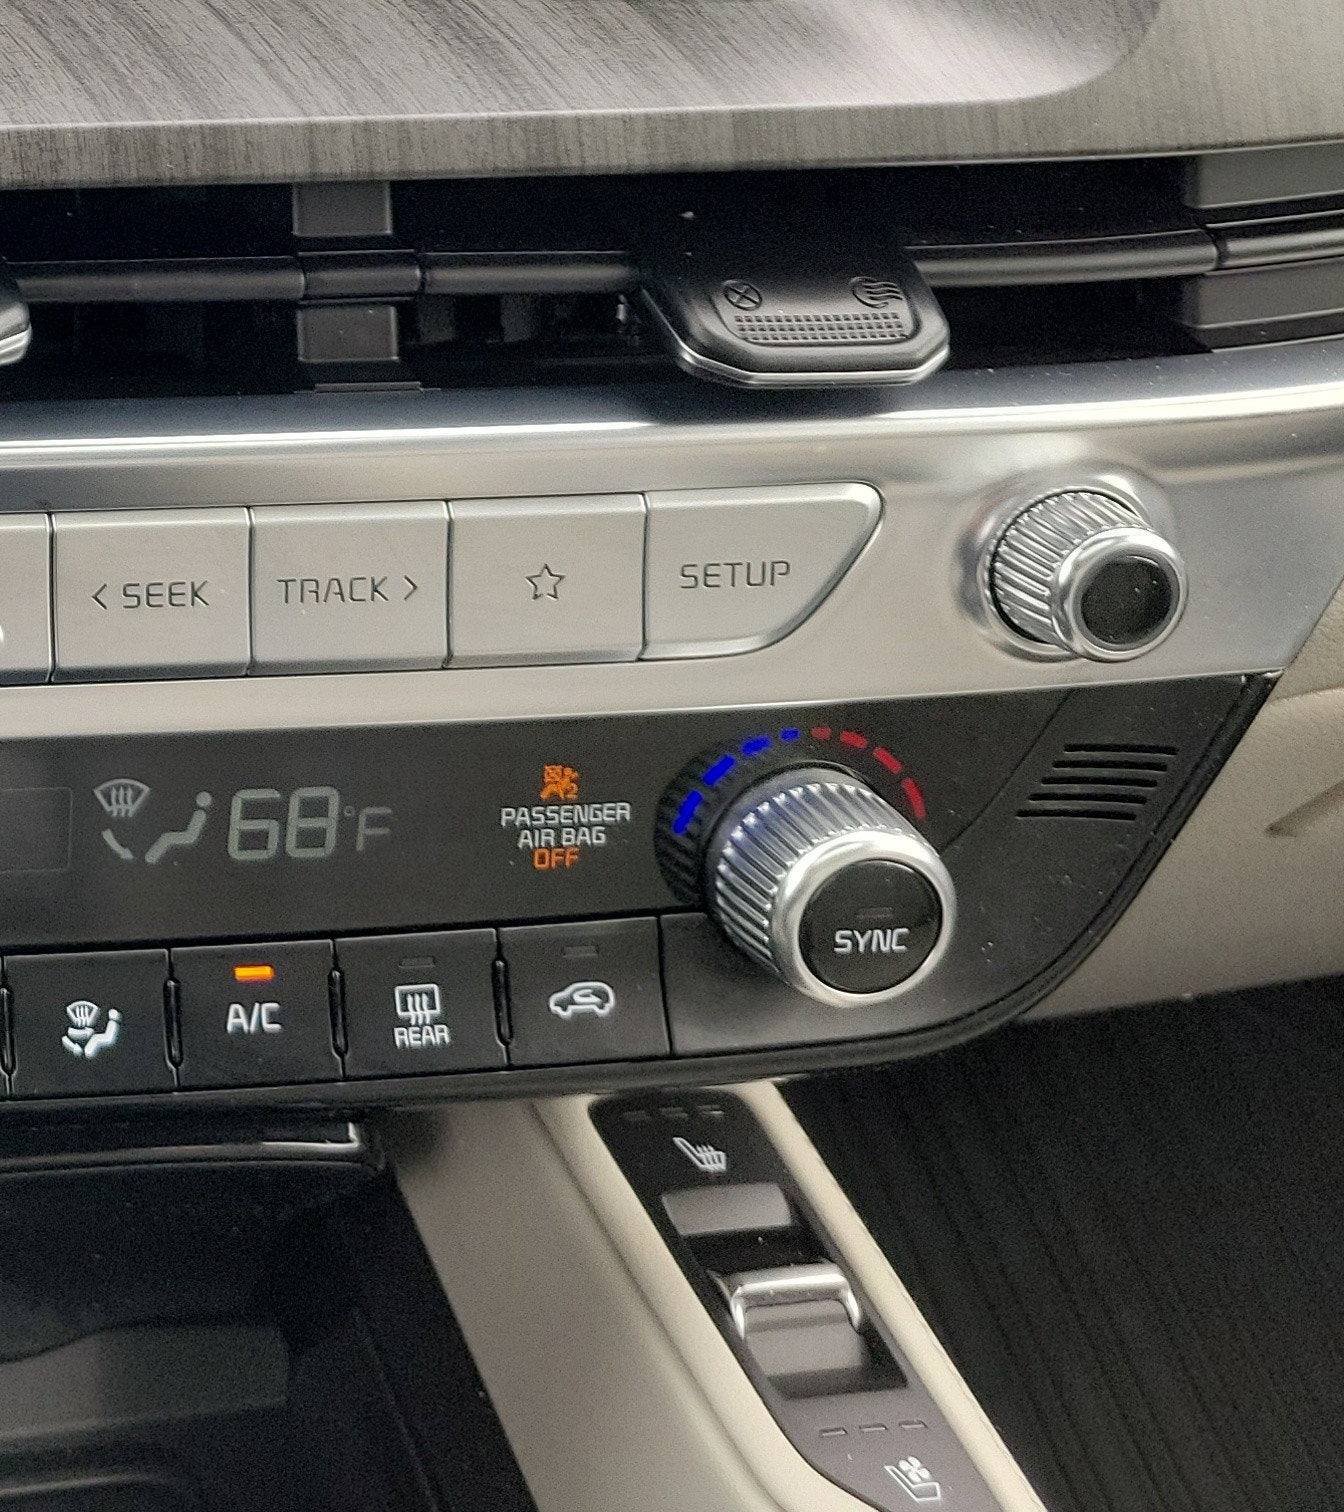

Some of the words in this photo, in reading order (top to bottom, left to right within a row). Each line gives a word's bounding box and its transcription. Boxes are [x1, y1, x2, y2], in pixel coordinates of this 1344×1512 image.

[678, 558, 790, 591] SETUP
[500, 801, 632, 828] PASSENGER
[517, 827, 556, 848] AIR
[560, 826, 607, 847] BAG
[534, 847, 579, 871] OFF
[834, 926, 910, 955] SYNC
[226, 1002, 281, 1034] A/C
[393, 1023, 450, 1047] REAR
